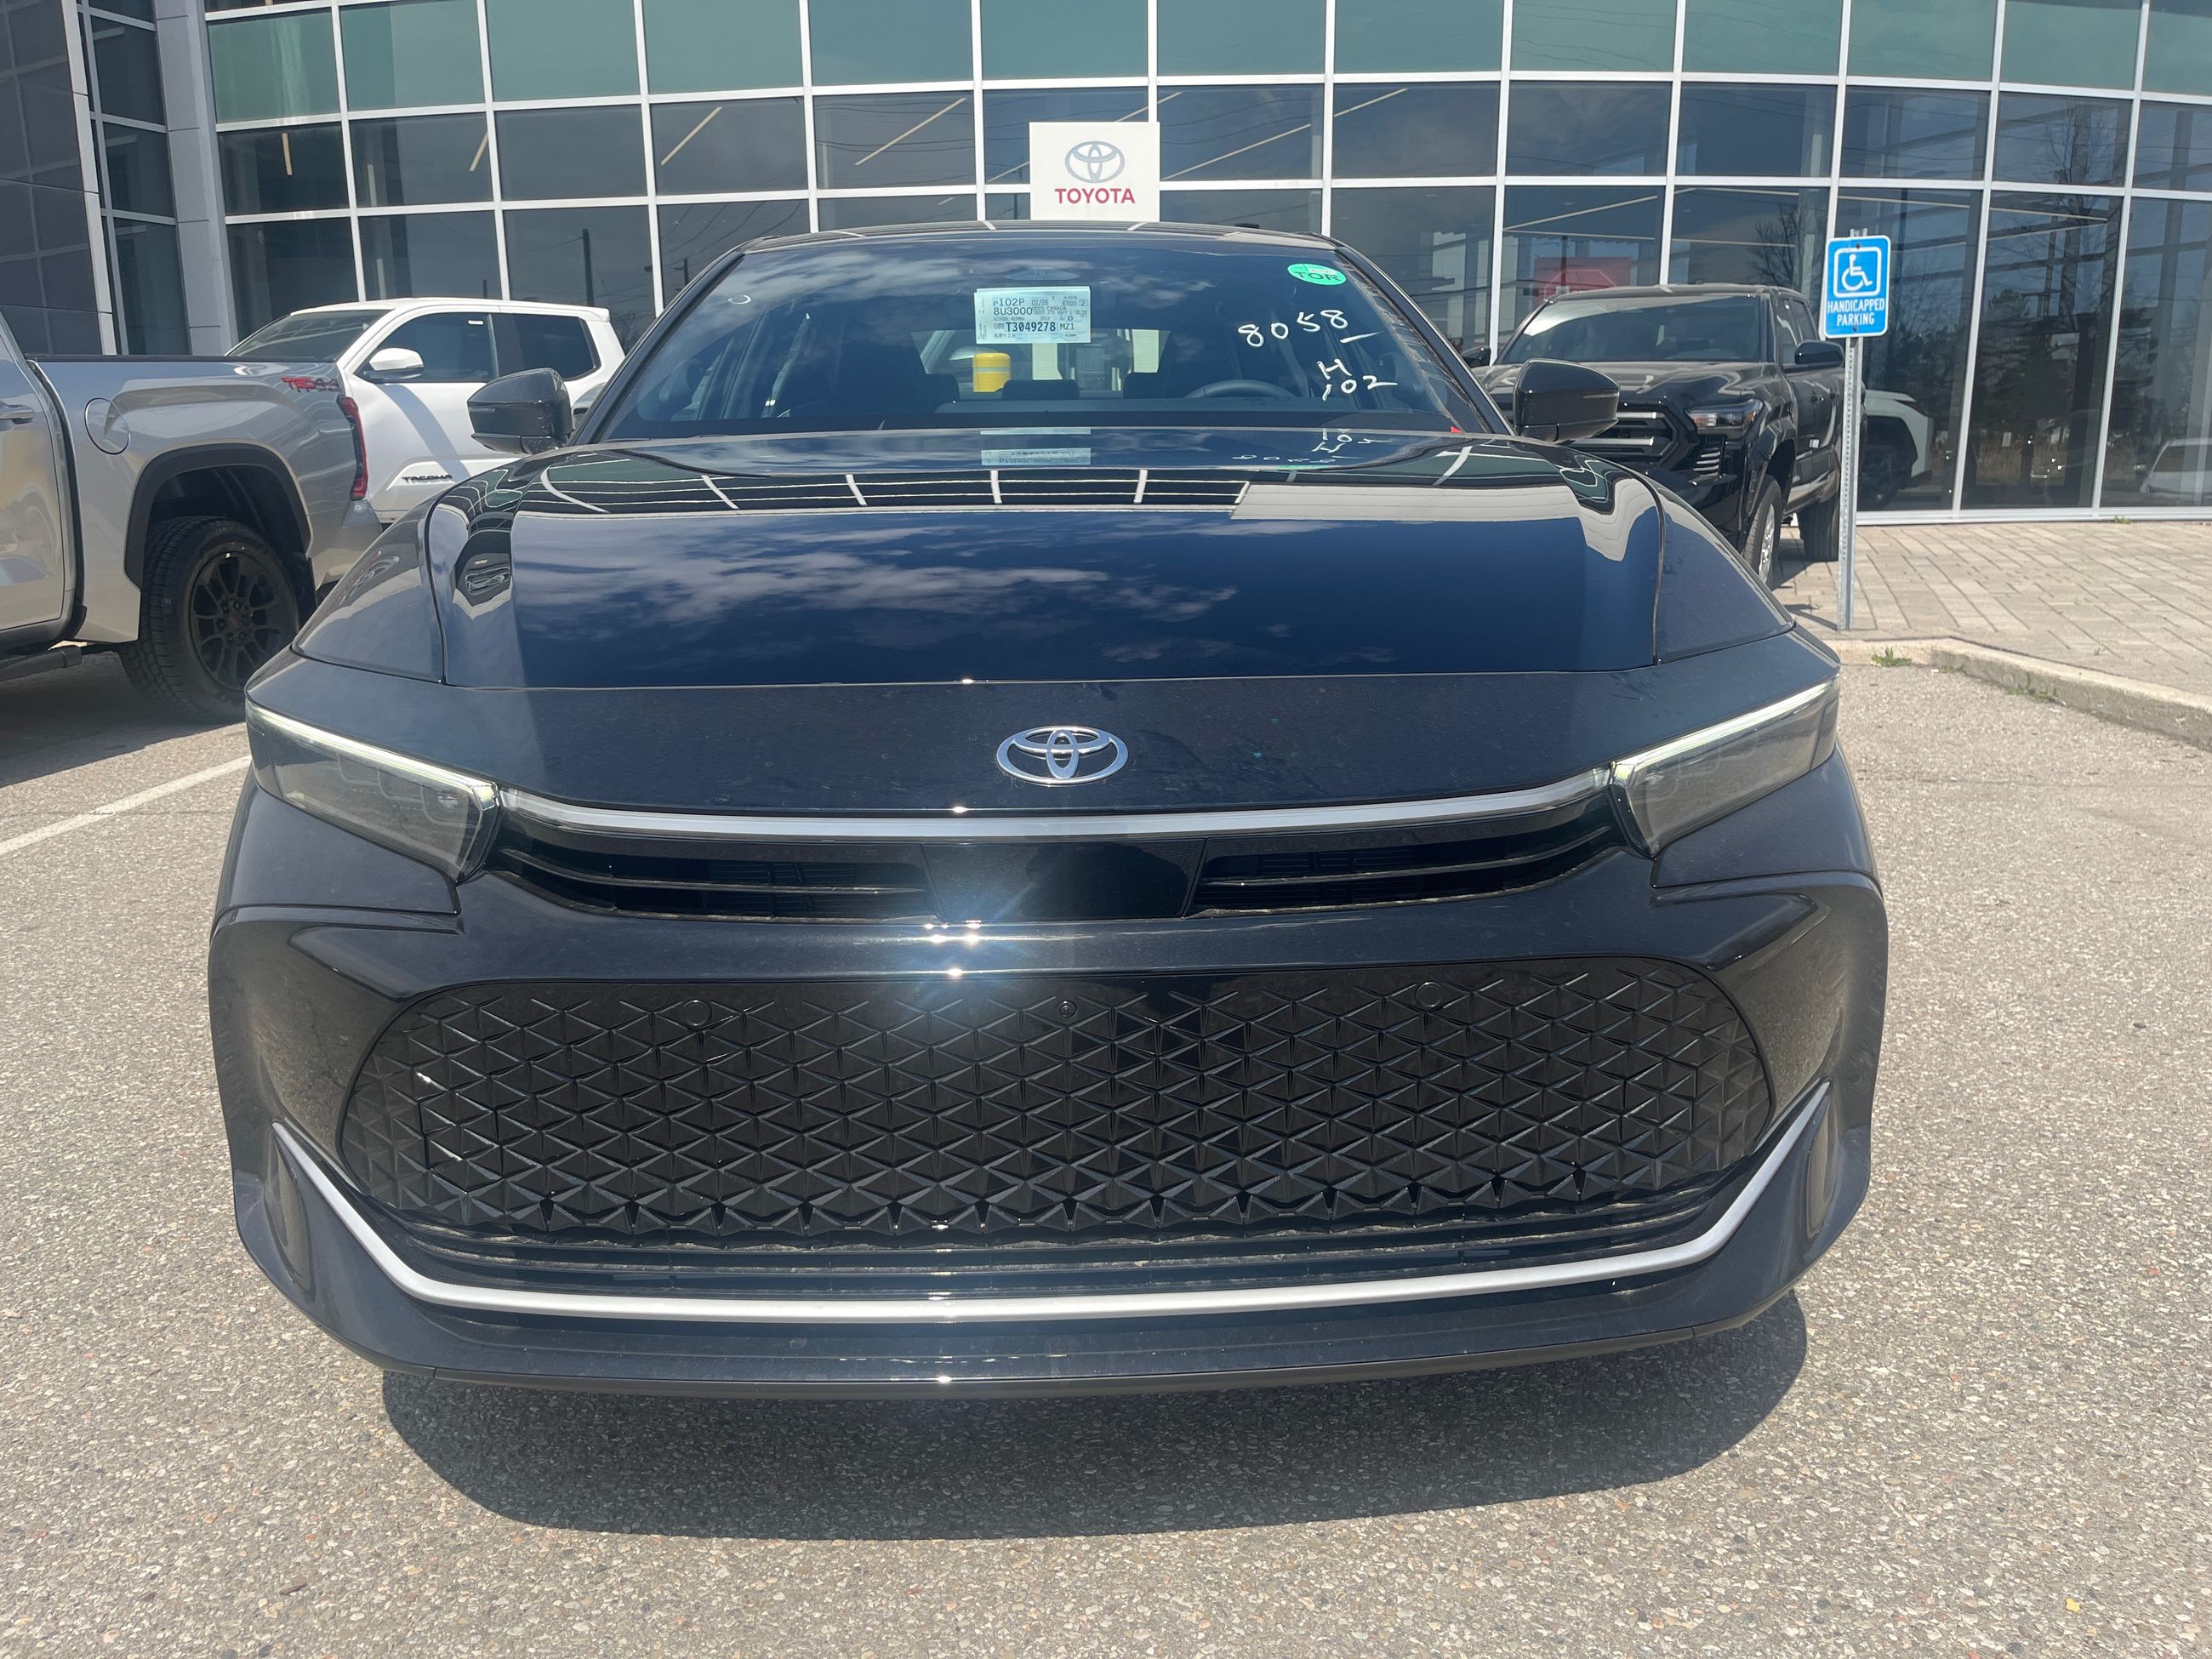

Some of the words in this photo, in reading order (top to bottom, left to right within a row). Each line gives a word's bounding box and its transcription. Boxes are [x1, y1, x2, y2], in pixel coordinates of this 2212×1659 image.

[1055, 187, 1136, 204] TOYOTA
[1293, 271, 1341, 282] TOR
[993, 307, 1033, 316] 8U3000
[1827, 298, 1885, 313] HANDICAPPED
[1836, 312, 1875, 327] PARKING
[1006, 322, 1056, 332] T3049278
